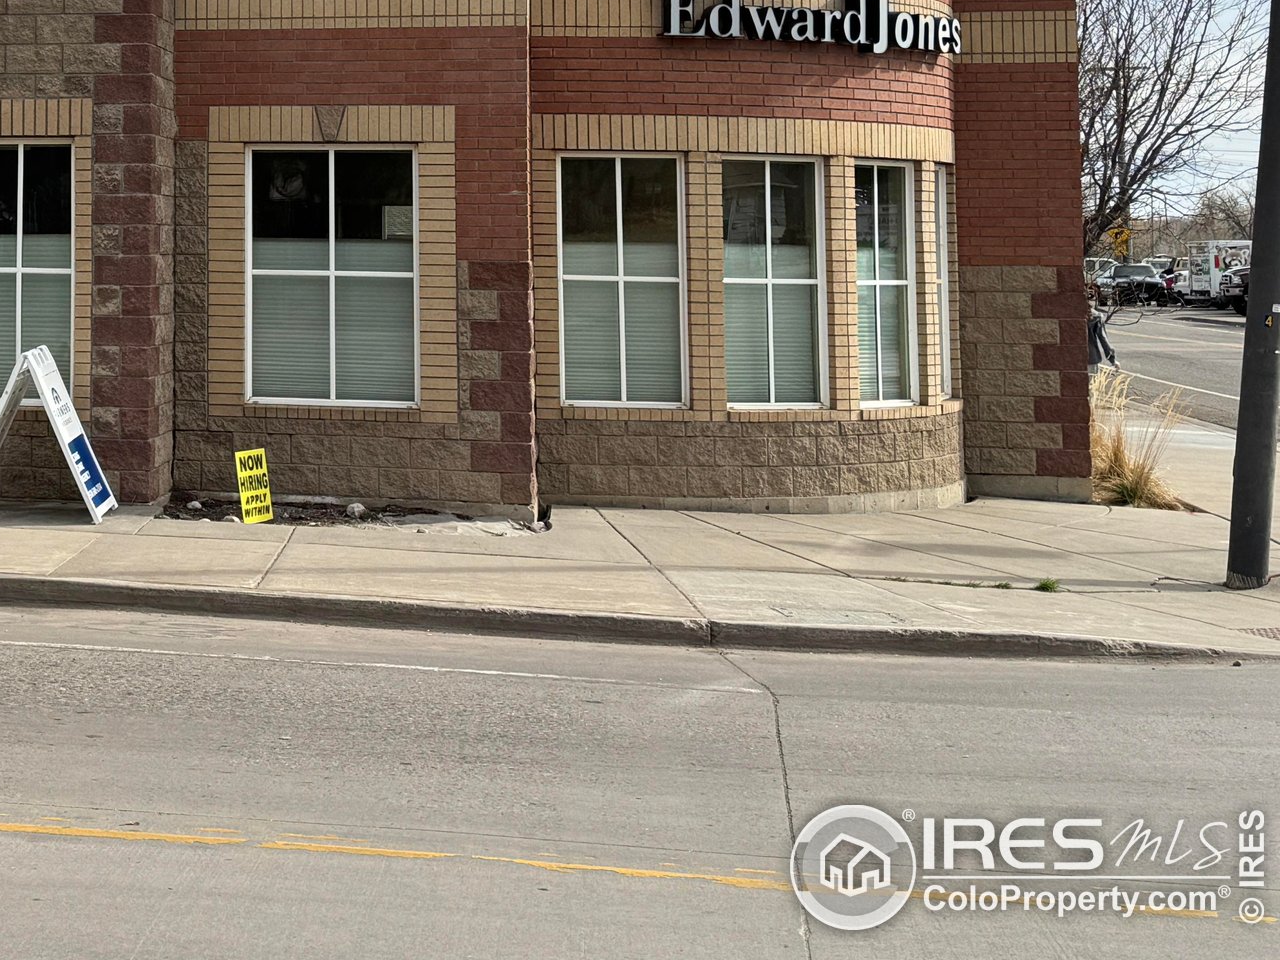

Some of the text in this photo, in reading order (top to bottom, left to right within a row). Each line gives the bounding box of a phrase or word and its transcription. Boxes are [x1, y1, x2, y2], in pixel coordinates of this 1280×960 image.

[1265, 315, 1273, 327] 4
[239, 453, 263, 472] NOW
[239, 473, 268, 493] HIRING
[245, 493, 267, 506] APPLY
[244, 504, 270, 518] WITHIN
